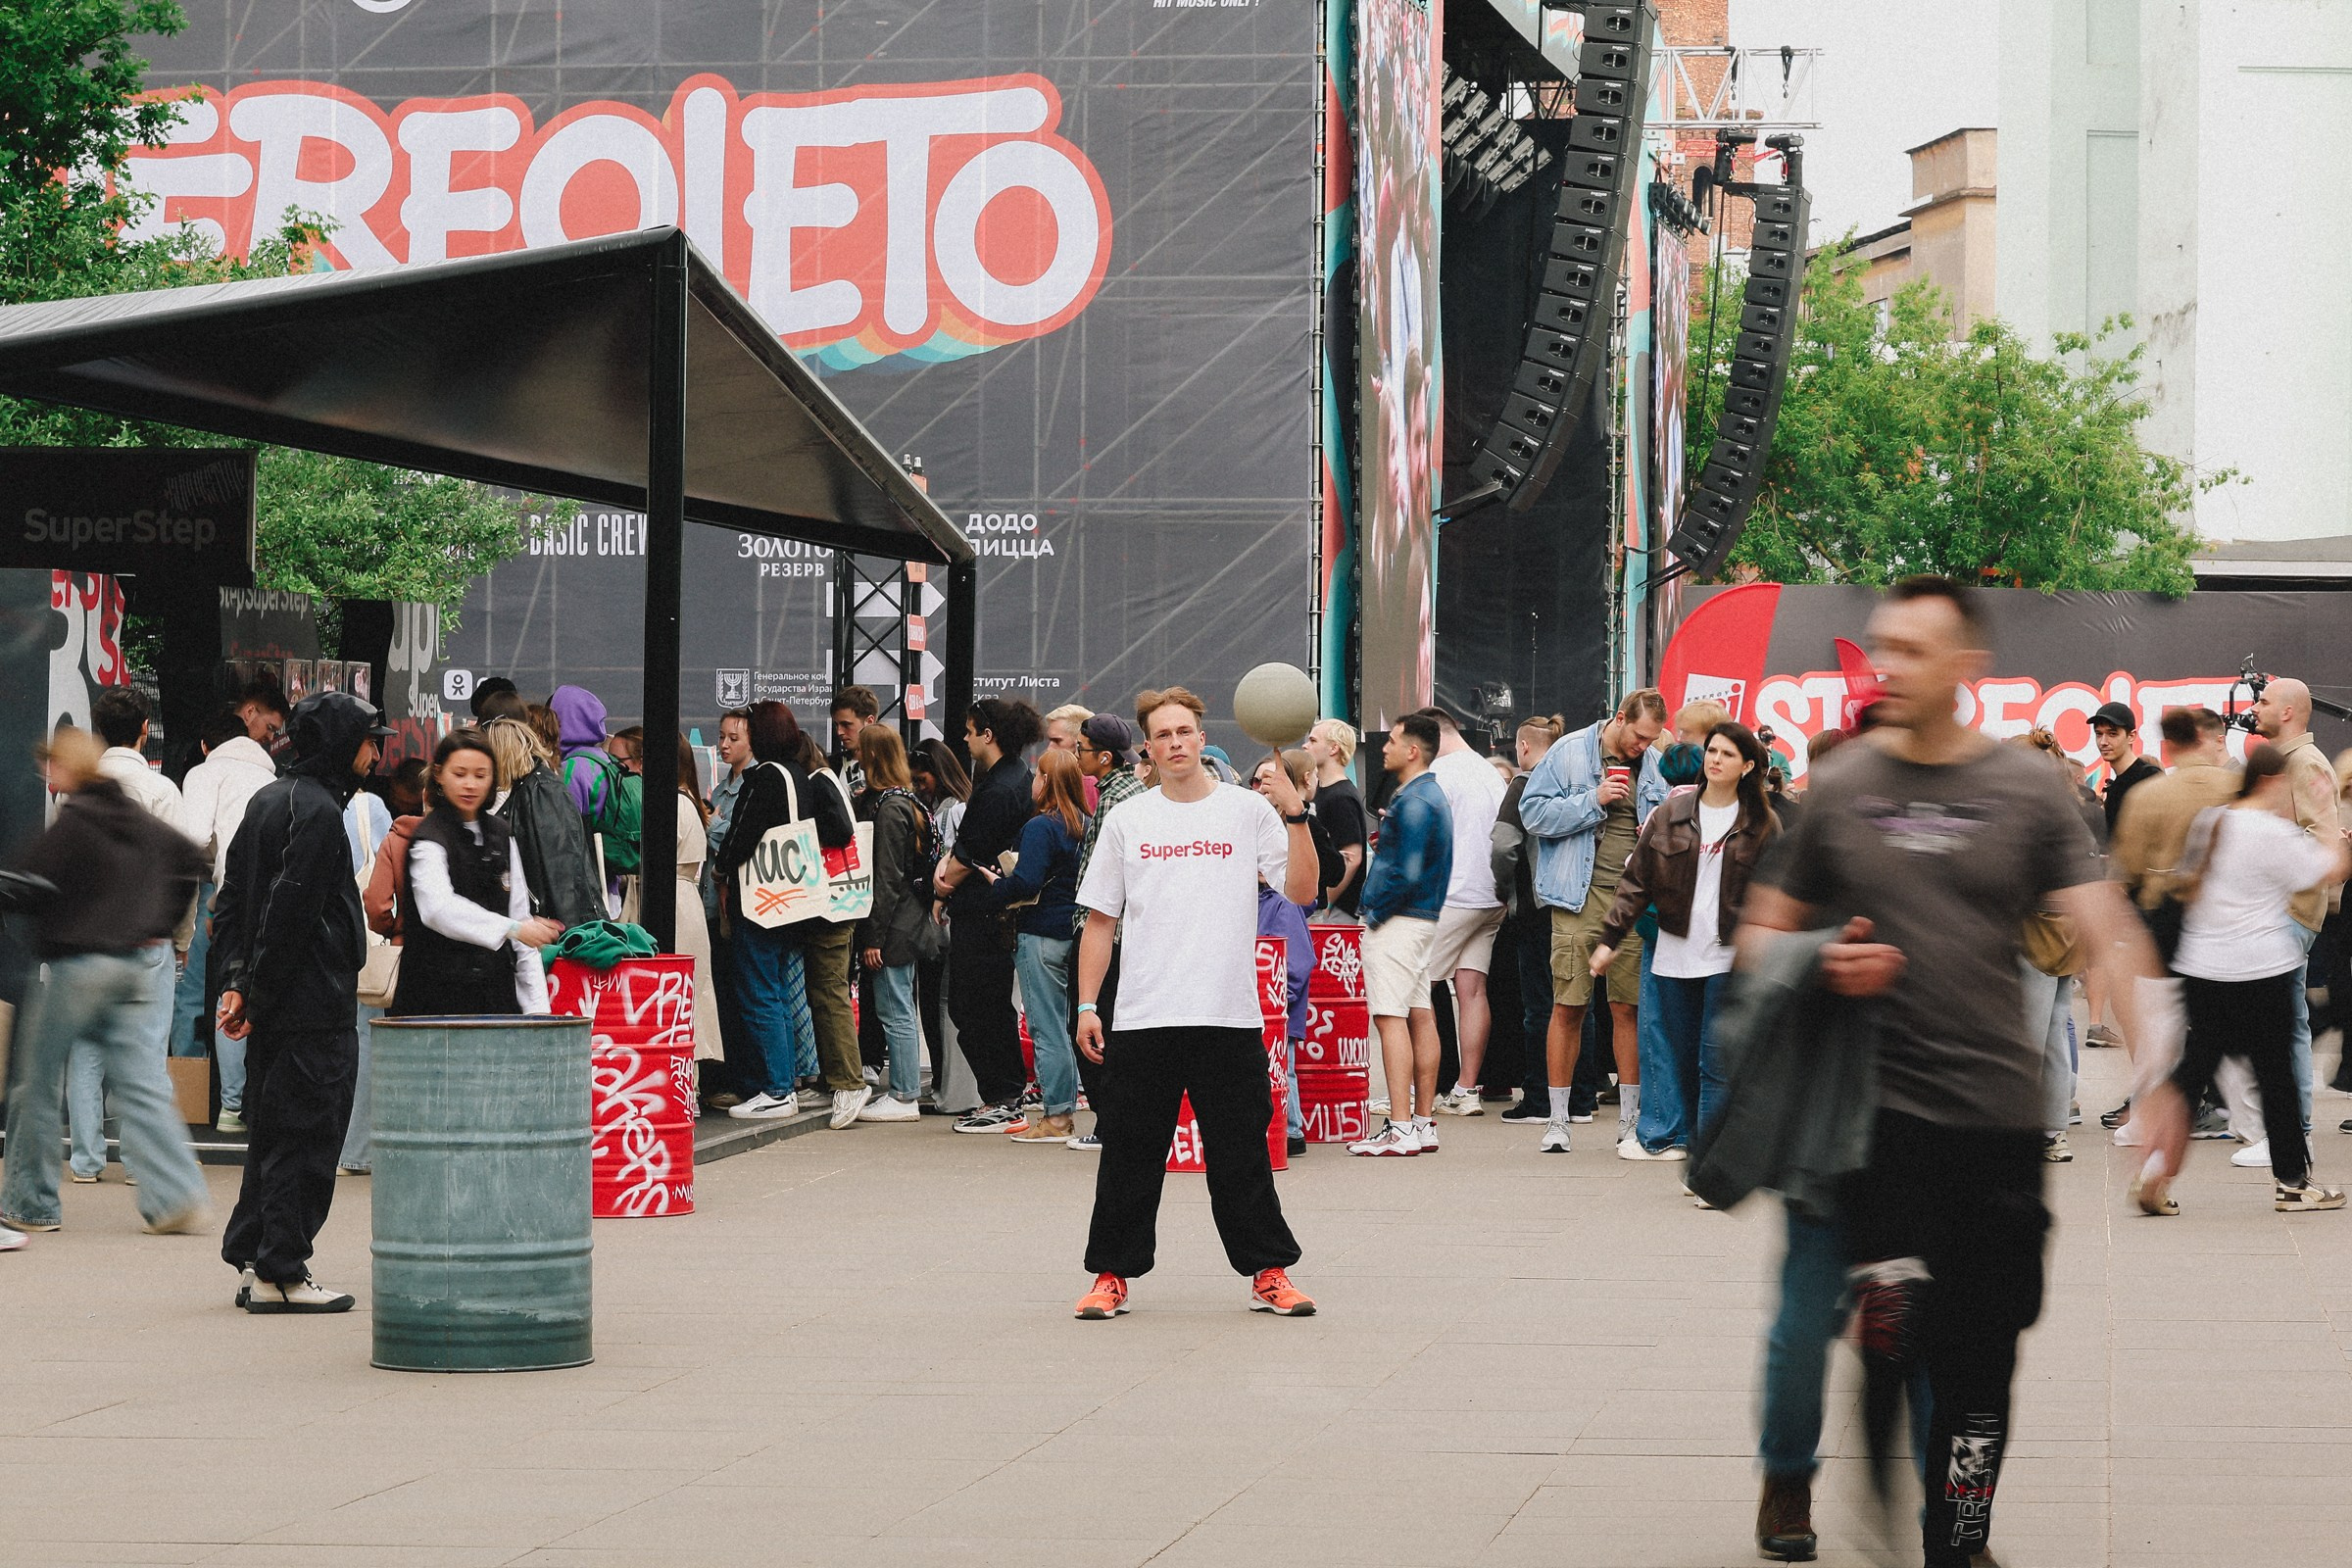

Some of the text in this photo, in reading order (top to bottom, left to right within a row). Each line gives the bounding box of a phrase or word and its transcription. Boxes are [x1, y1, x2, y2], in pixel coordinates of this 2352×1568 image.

[24, 508, 217, 551] SuperStep
[965, 514, 1038, 534] ДОДО
[737, 533, 833, 559] ЗОЛОТО
[760, 563, 825, 577] РЕЗЕРВ
[754, 671, 809, 682] Генеральное
[1018, 675, 1060, 687] Листа
[754, 683, 807, 695] Государства
[1140, 840, 1233, 861] SuperStep
